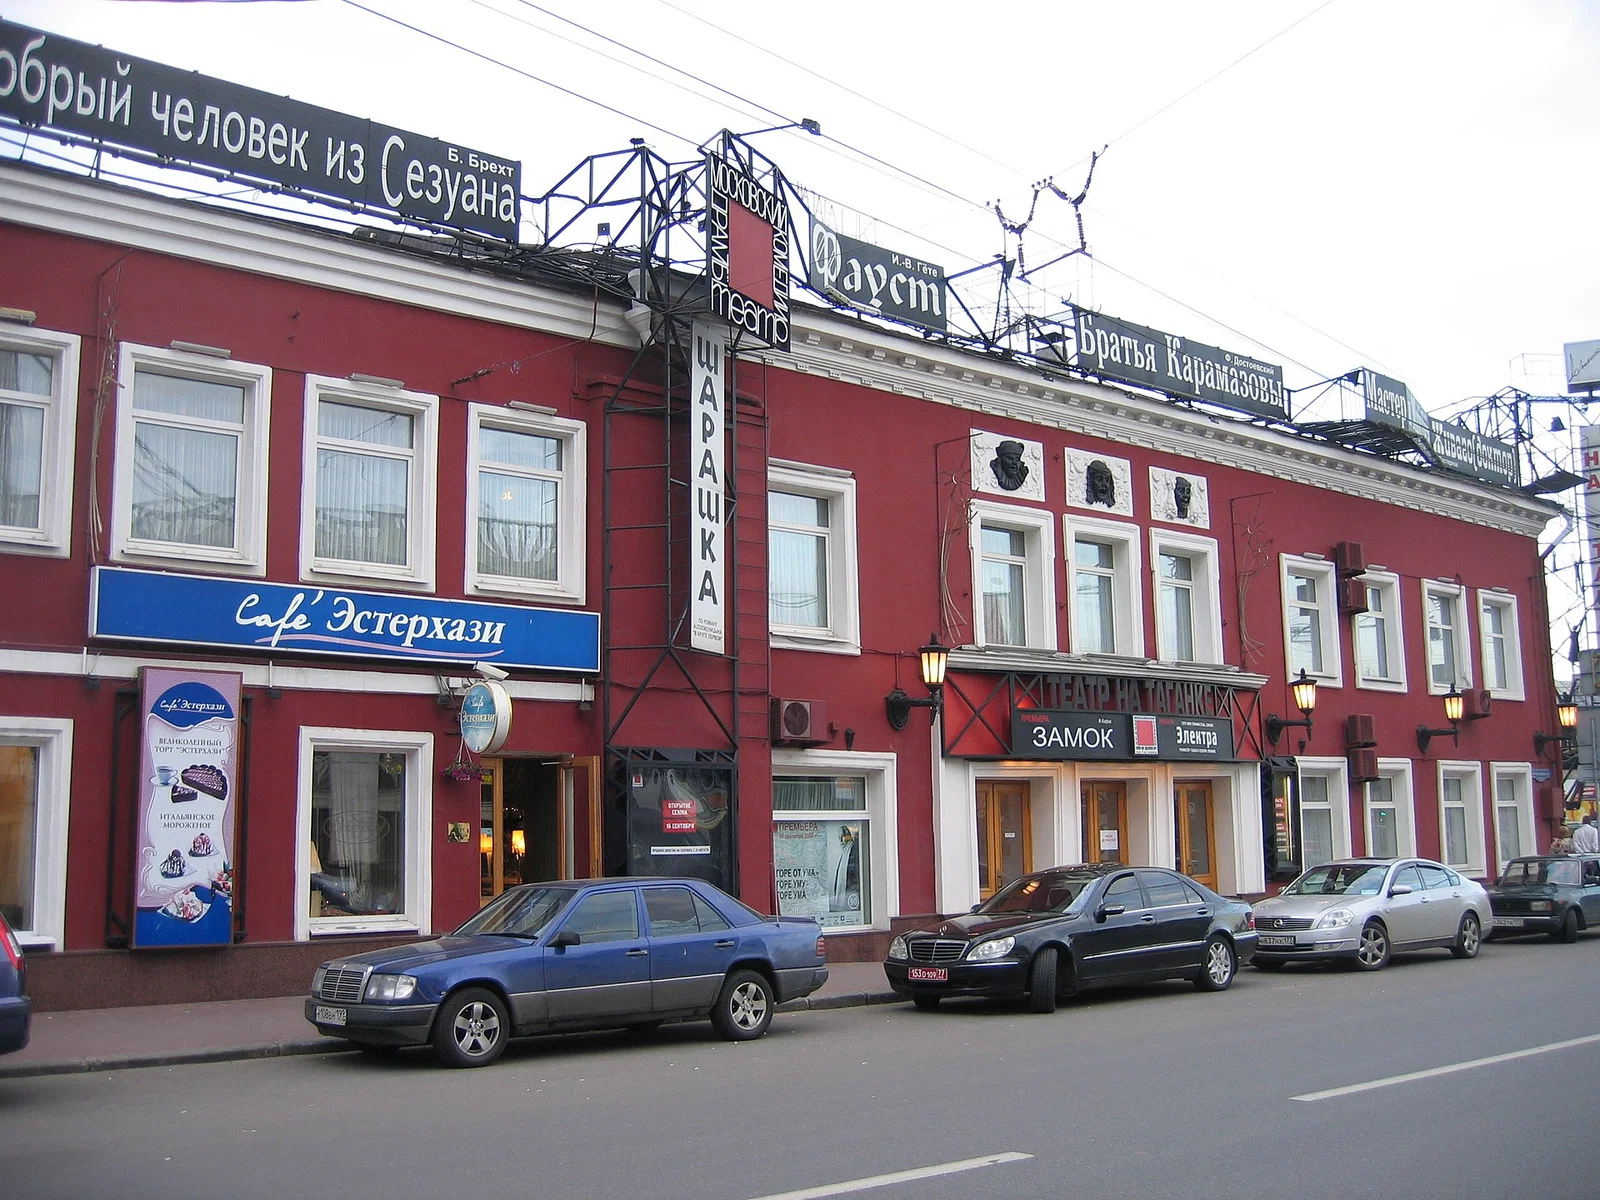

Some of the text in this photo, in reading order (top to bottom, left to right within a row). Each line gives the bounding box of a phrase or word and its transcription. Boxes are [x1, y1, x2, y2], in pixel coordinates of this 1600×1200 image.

[151, 89, 309, 171] человек
[325, 136, 365, 184] из
[380, 134, 517, 224] Сезуана
[448, 147, 514, 177] Б. Брехт
[710, 156, 788, 228] МОСКОВСКИЙ
[773, 224, 788, 322] КОМЕДИИ
[812, 223, 942, 317] Фауст
[917, 260, 938, 278] Гёте
[1079, 312, 1283, 408] Братья Карамазовы
[1234, 356, 1275, 376] Достоевский
[1365, 370, 1406, 429] Мастер
[697, 335, 720, 606] ШАРАШКА
[326, 596, 507, 647] Эстерхази
[181, 701, 225, 713] Эстерхази
[1048, 674, 1214, 716] ТЕАТР НА ТАГАНКЕ
[158, 737, 222, 747] ВЕЛИКОЛЕПНЫЙ
[1032, 726, 1114, 749] ЗАМОК
[1176, 725, 1218, 749] Электра
[159, 813, 215, 821] ИТАЛЬЯНСКОЕ
[779, 822, 818, 831] ПРЕМЬЕРА
[776, 869, 791, 877] ГОРЕ
[792, 869, 801, 877] ОТ
[776, 880, 792, 888] ГОРЕ
[793, 890, 806, 899] УМА
